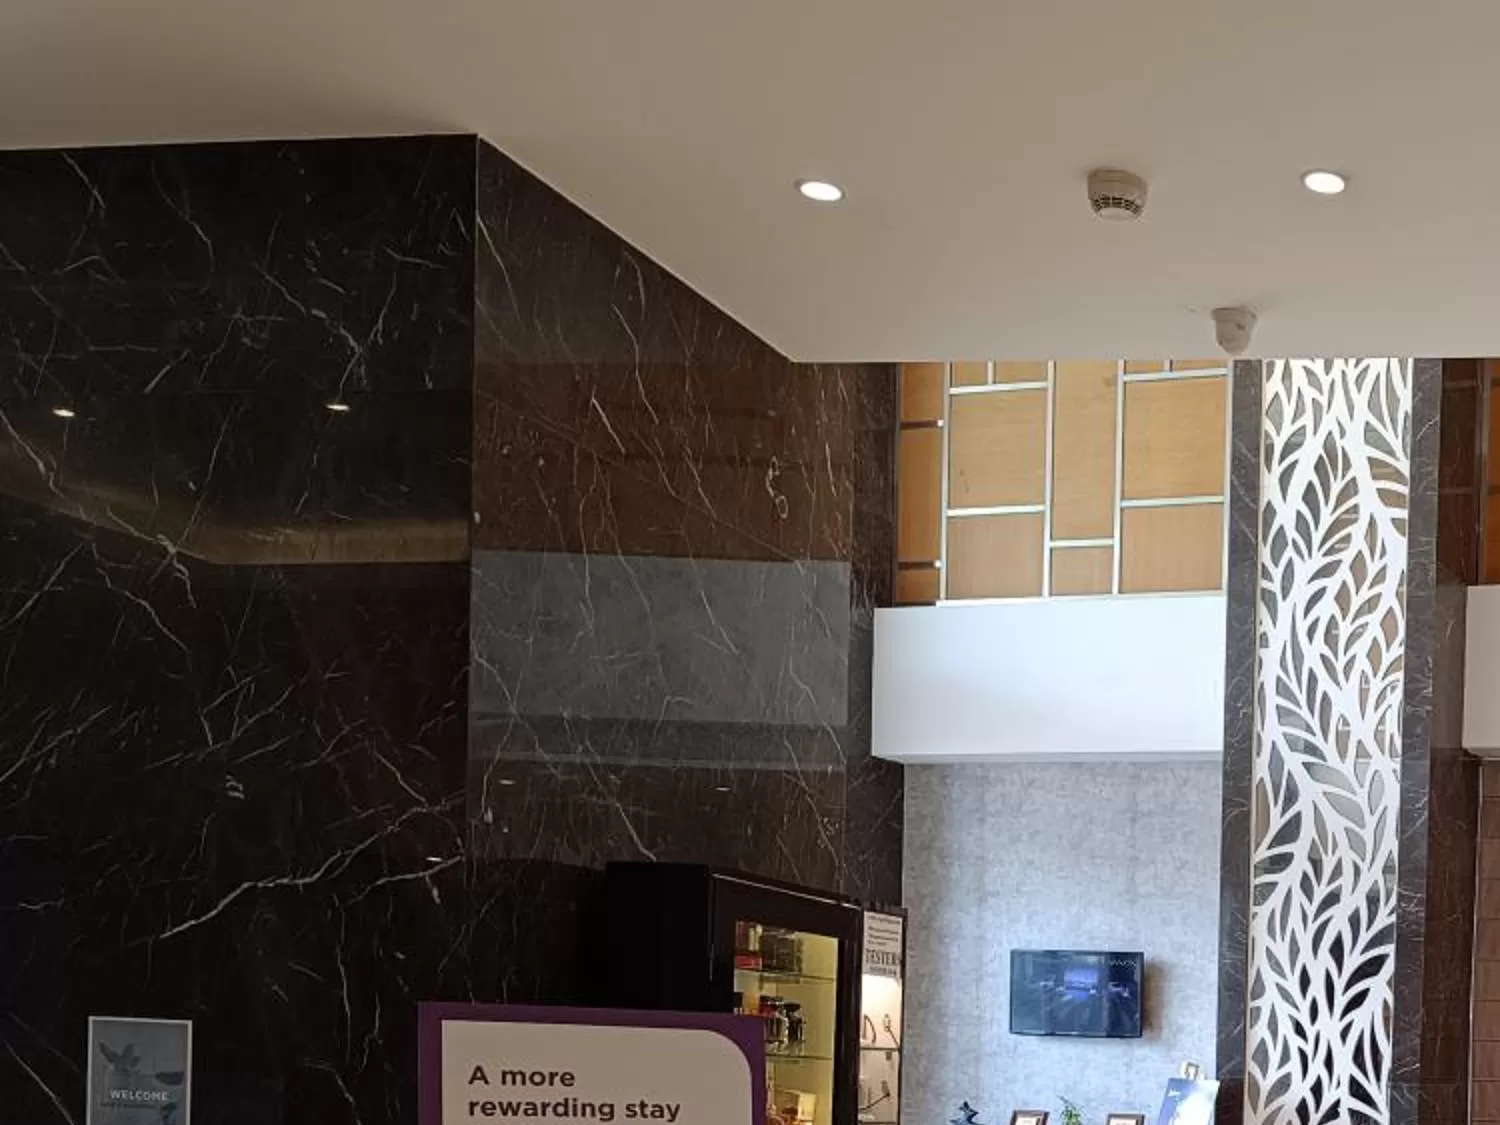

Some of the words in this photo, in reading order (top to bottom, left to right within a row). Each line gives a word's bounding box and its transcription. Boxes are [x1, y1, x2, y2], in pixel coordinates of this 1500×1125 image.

[468, 1065, 490, 1085] A
[501, 1069, 575, 1087] more
[109, 1089, 168, 1101] WELCOME
[468, 1098, 615, 1122] rewarding
[625, 1100, 681, 1122] stay
